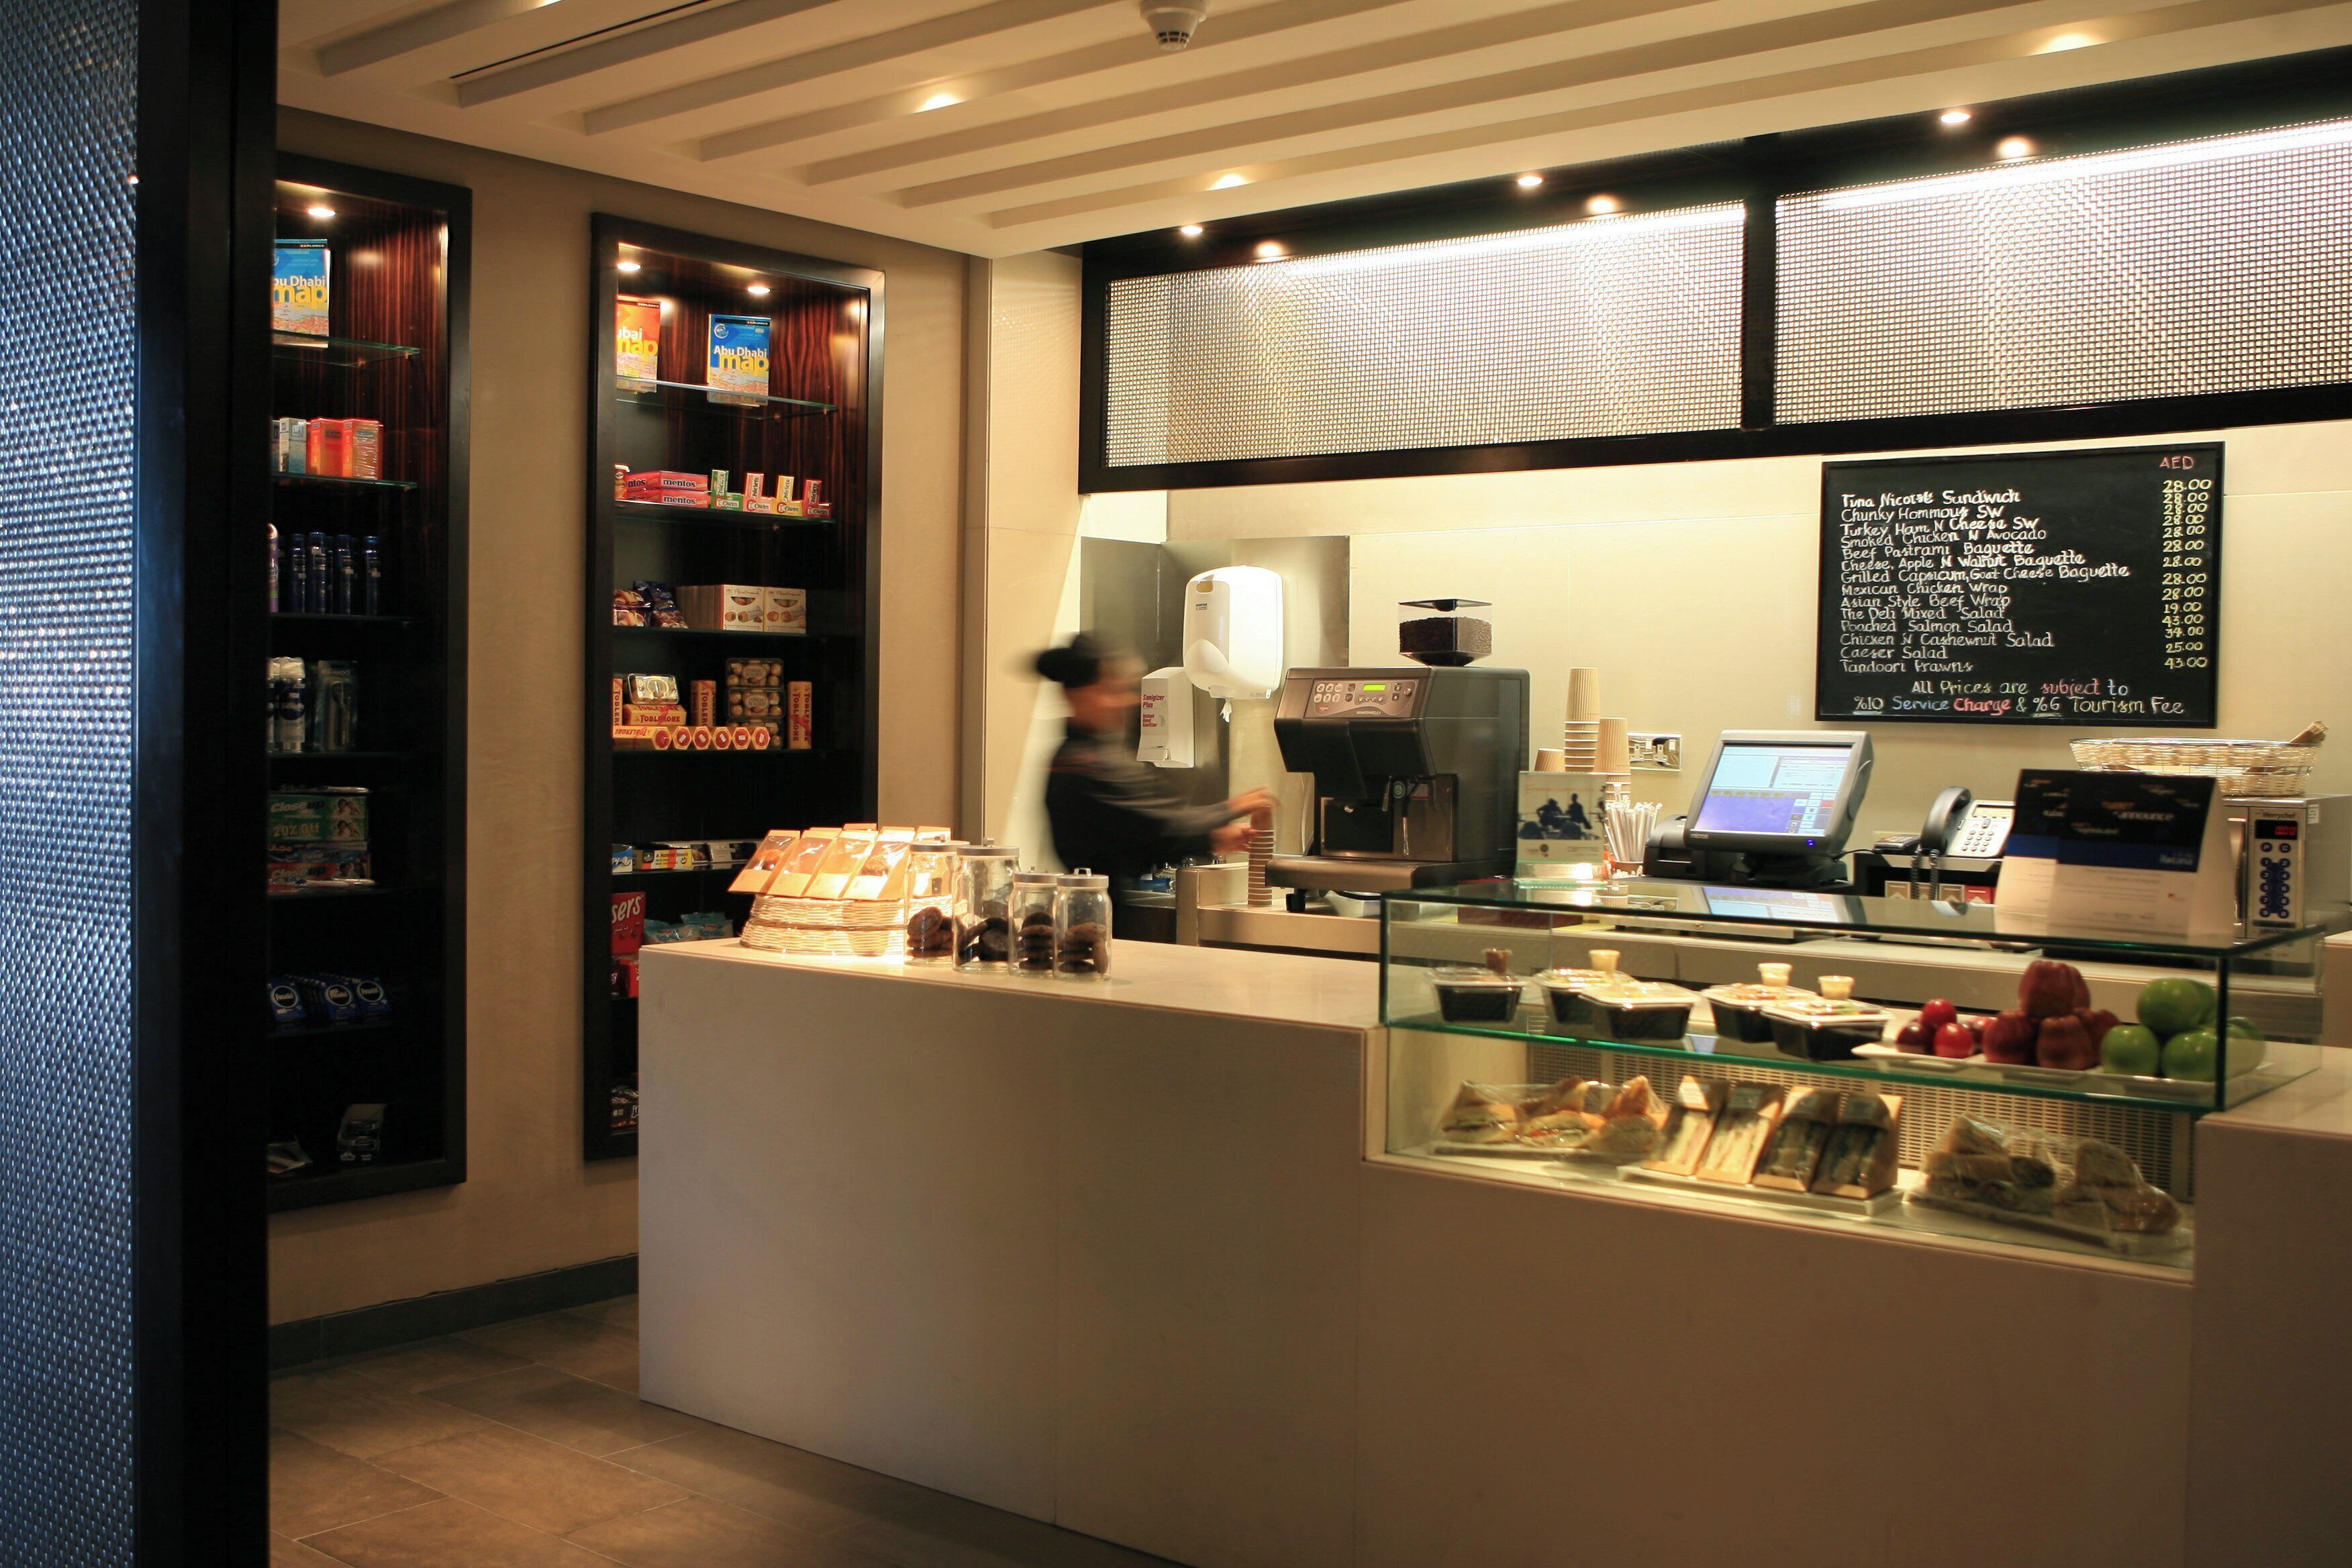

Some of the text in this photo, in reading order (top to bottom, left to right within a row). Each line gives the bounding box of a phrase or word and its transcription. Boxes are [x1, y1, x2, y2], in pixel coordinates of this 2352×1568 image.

[290, 275, 325, 287] Dhabi
[273, 285, 328, 309] map
[714, 345, 767, 358] Abu Dhabi
[719, 354, 769, 376] map
[2159, 456, 2194, 470] AED
[628, 479, 646, 488] ntos
[663, 479, 696, 487] mentos
[2162, 479, 2212, 493] 28.00
[663, 496, 696, 505] mentos
[1841, 493, 1875, 507] Tuna
[2163, 492, 2208, 503] 28.00
[1841, 507, 1895, 523] Chunky
[1976, 505, 2004, 518] SW
[2163, 503, 2208, 515] 28.00
[1840, 516, 2041, 538] Turkey Ham N Cheese SW
[2162, 514, 2204, 526] 28.00
[1841, 529, 2047, 548] Smoked Chicken N Avocado
[2162, 525, 2205, 538] 28.00
[1842, 541, 2035, 560] Beef Pastrami Baguette
[2163, 539, 2204, 552] 28.00
[1898, 556, 1934, 571] Apple
[1940, 555, 1953, 569] N
[2014, 549, 2086, 569] Baguette
[2163, 555, 2202, 567] 28.00
[1841, 571, 1890, 584] Grilled
[2004, 566, 2053, 579] Cheese
[2059, 562, 2130, 583] Baguette
[2162, 573, 2206, 585] 28.00
[1841, 584, 1899, 596] Mexican
[1907, 581, 1965, 593] Chicken
[2161, 586, 2204, 600] 28.00
[1841, 594, 2010, 611] Asian Style Beef Wrap
[2163, 601, 2202, 614] 19.00
[1840, 606, 2005, 620] The Deli Mixed Salad
[1908, 619, 1961, 632] Salmon
[1967, 618, 2014, 633] Salad
[2161, 614, 2204, 628] 43.00
[1840, 633, 1895, 646] Chicken
[1900, 632, 1913, 645] N
[2005, 631, 2056, 647] Salad
[2165, 626, 2204, 638] 34.00
[1902, 645, 1949, 658] Salad
[2165, 641, 2203, 653] 25.00
[1839, 658, 1974, 673] Tandoori Prawns
[2164, 656, 2207, 669] 43.00
[1912, 678, 2128, 696] All Prices are subject to
[701, 691, 709, 726] TOBLER
[1853, 695, 2184, 716] %10 Service Charge & %6 Tourism Fee
[273, 822, 320, 838] 20% Off
[611, 896, 642, 924] sers
